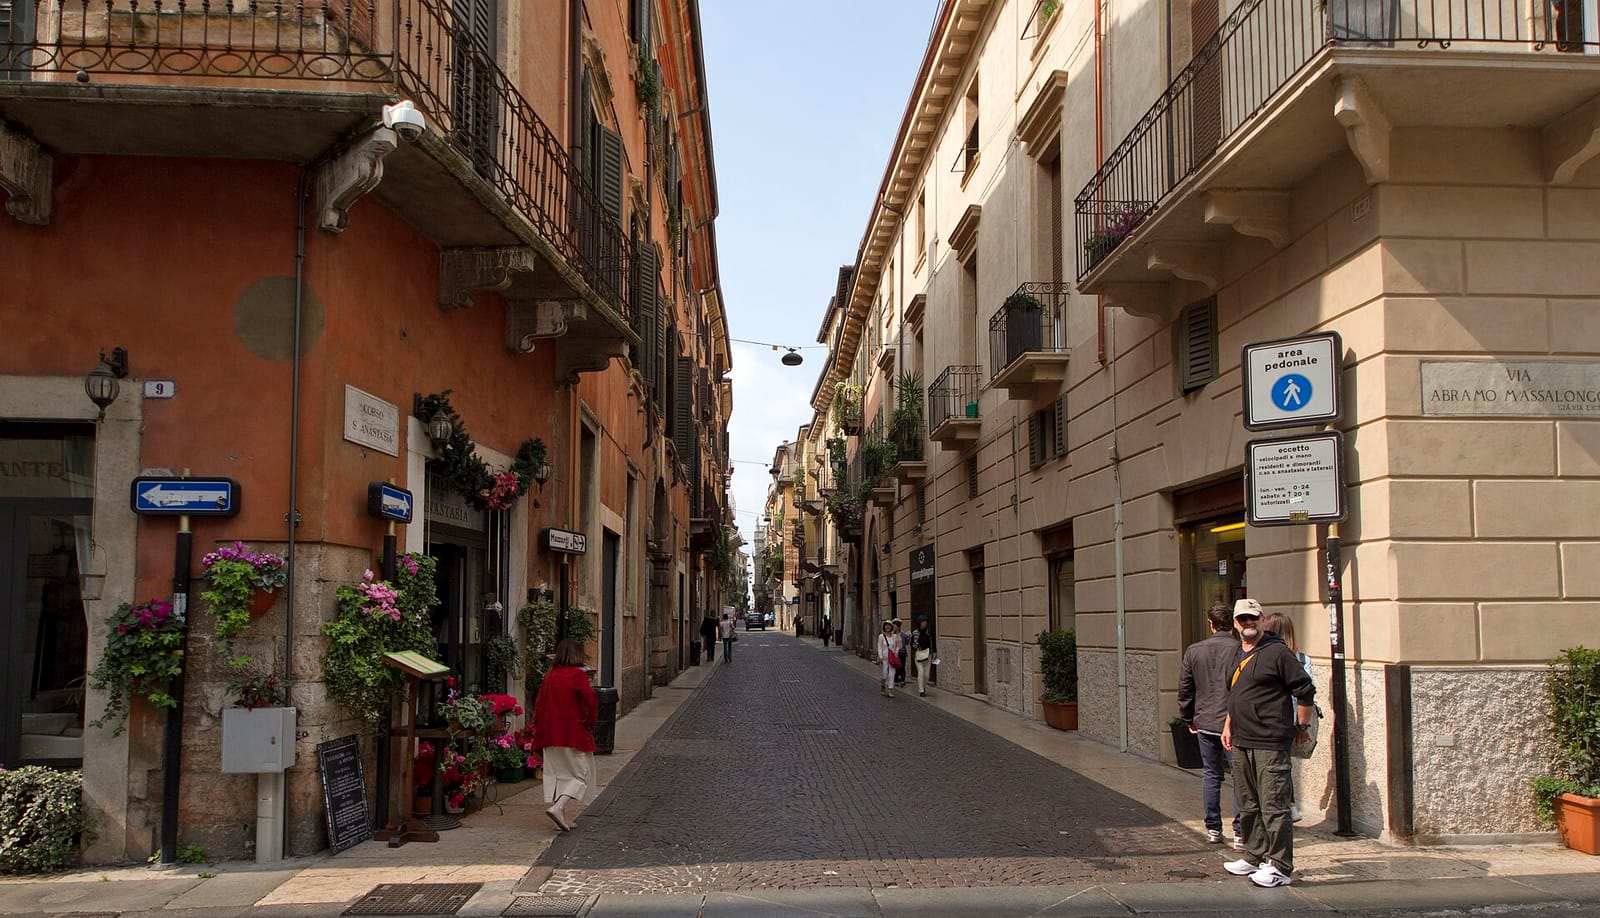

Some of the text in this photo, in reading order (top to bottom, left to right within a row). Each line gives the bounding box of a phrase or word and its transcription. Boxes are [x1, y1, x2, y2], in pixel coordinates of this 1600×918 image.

[1278, 349, 1303, 358] area
[1265, 356, 1318, 372] pedonale
[1506, 369, 1531, 382] VIA
[156, 383, 164, 395] 9
[1431, 389, 1600, 402] ABRAMO MASSALONG
[1278, 445, 1309, 453] eccetto
